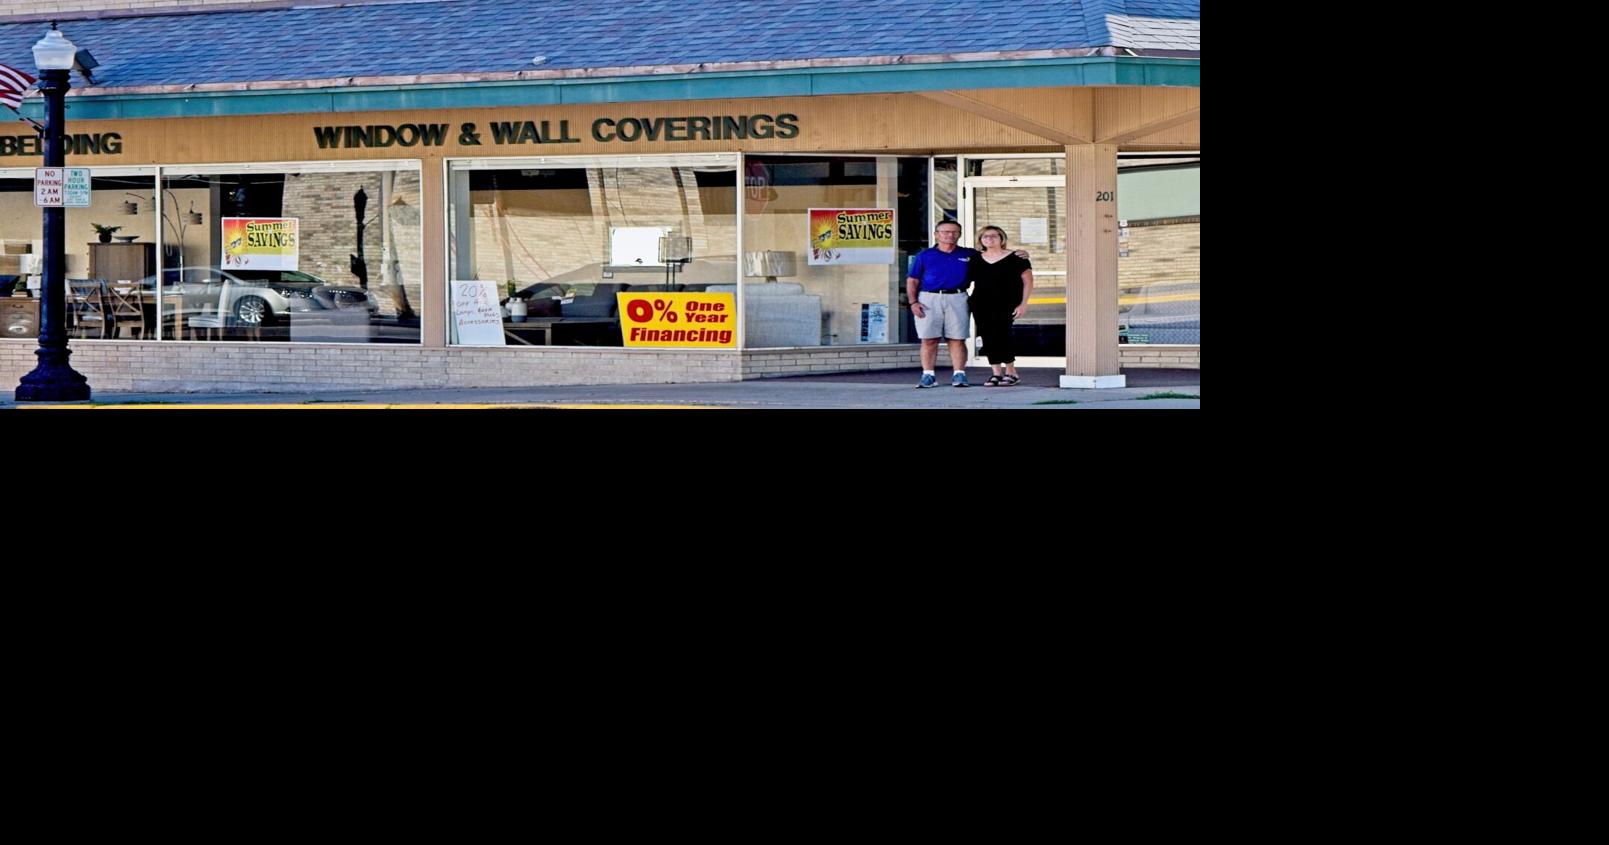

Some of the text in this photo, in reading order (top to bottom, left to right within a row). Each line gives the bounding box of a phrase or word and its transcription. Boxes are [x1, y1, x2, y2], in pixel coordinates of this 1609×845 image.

[313, 113, 800, 149] WINDOW & WALL COVERINGS
[745, 176, 766, 199] TOP
[1096, 191, 1114, 202] 201
[837, 212, 889, 224] Summer
[246, 222, 292, 232] Summer
[838, 224, 893, 240] SAVINGS
[247, 233, 296, 247] SAVINGS
[460, 284, 488, 298] 20%
[627, 299, 725, 323] 0% One
[685, 313, 728, 323] Year
[630, 328, 732, 344] Financing
